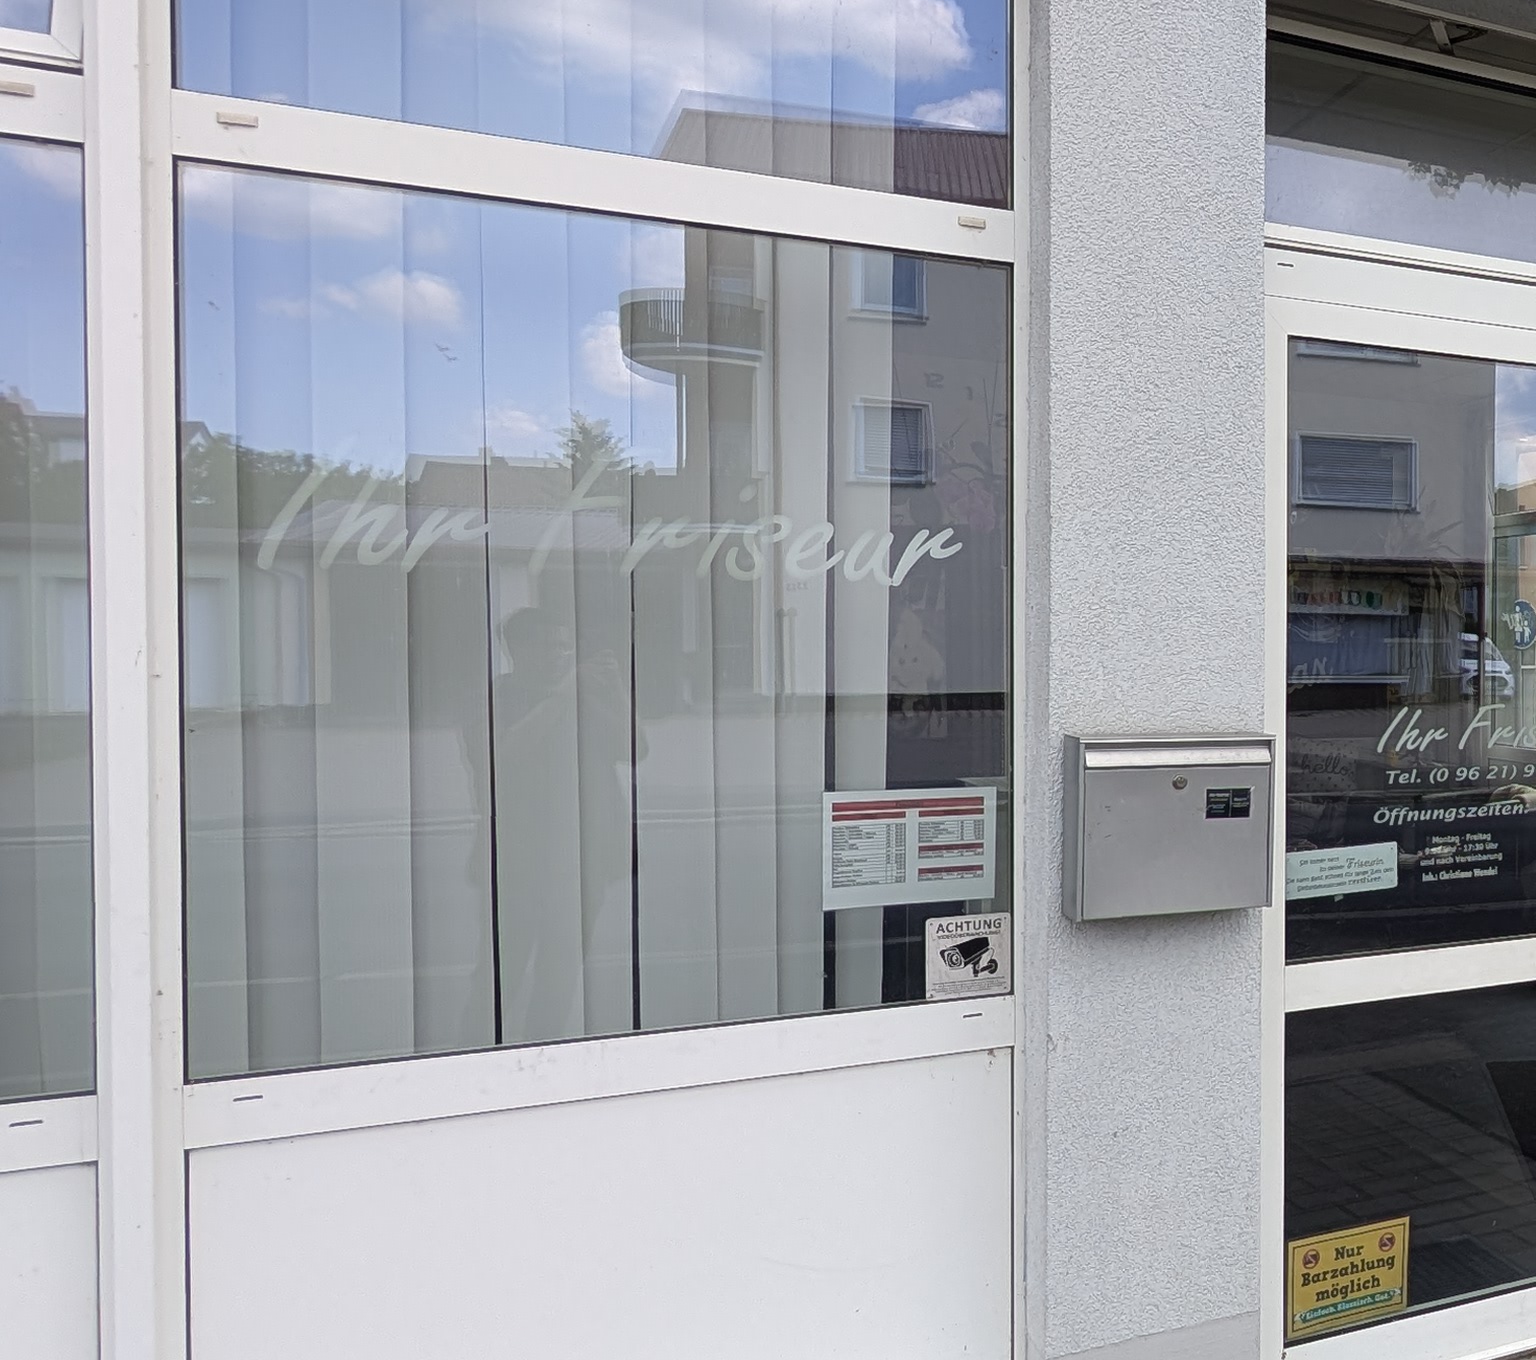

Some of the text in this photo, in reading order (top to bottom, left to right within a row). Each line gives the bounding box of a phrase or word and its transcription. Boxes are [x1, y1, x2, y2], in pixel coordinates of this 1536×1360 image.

[257, 450, 963, 587] Ihr Friseur
[1377, 706, 1448, 753] Ihr
[1386, 769, 1421, 785] Tel.
[1429, 768, 1449, 785] (0
[1455, 766, 1480, 781] 96
[1486, 764, 1517, 780] 21)
[1431, 835, 1460, 845] Montag
[1465, 832, 1492, 841] Freitag
[935, 918, 1002, 934] ACHTUNG
[1334, 1245, 1365, 1261] Nur
[1301, 1254, 1396, 1288] Barzahlung
[1315, 1274, 1381, 1303] möglich
